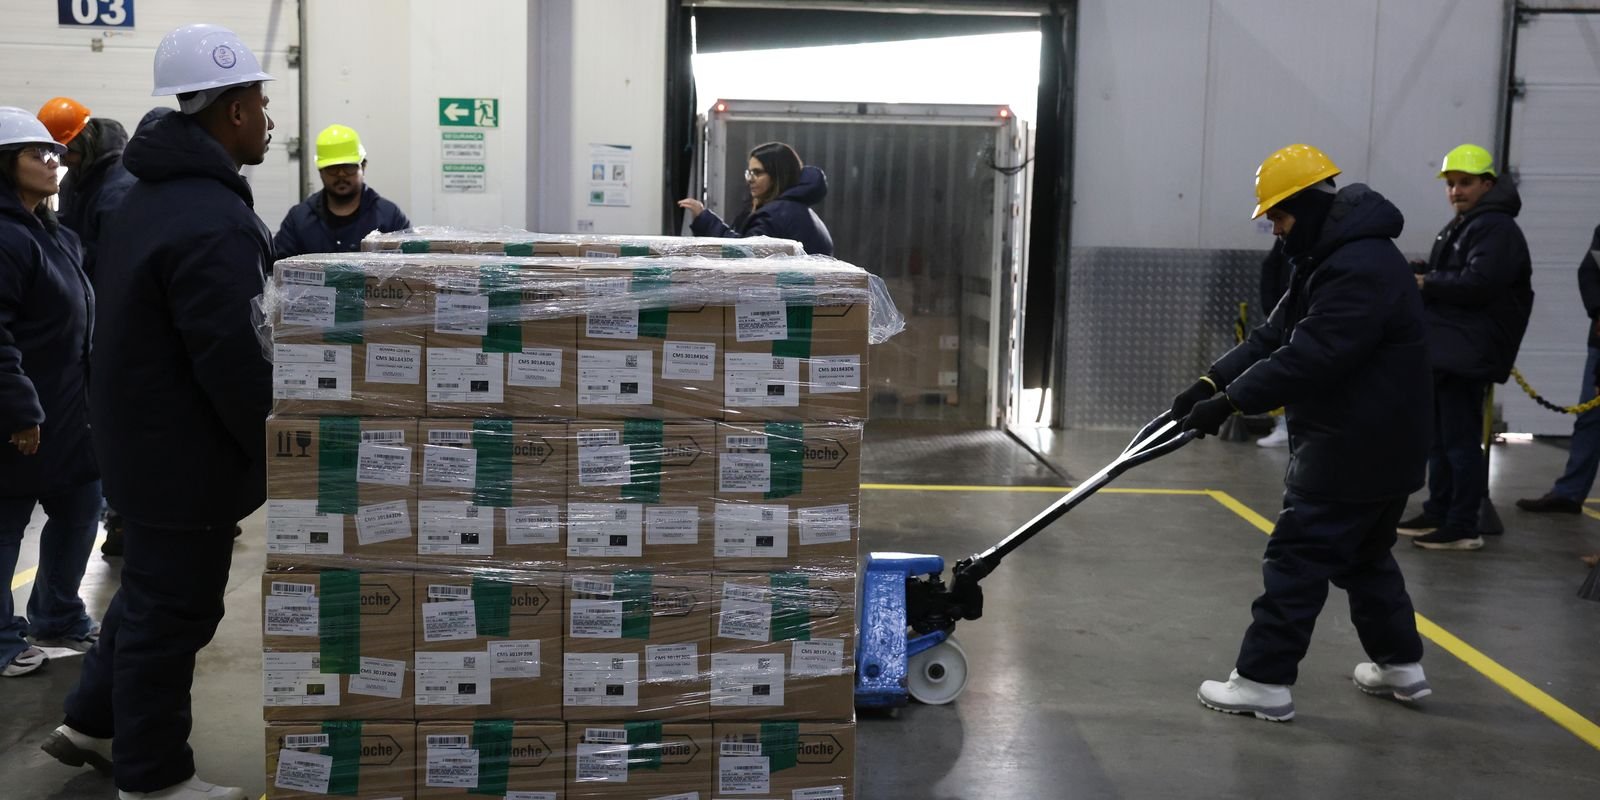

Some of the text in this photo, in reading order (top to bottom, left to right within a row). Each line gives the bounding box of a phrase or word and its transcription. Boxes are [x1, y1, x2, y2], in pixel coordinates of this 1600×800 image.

[71, 0, 128, 25] 03
[513, 443, 544, 456] oche
[360, 592, 390, 606] oche
[512, 593, 539, 606] oche
[363, 743, 393, 757] oche
[513, 744, 542, 758] oche
[662, 744, 690, 756] oche
